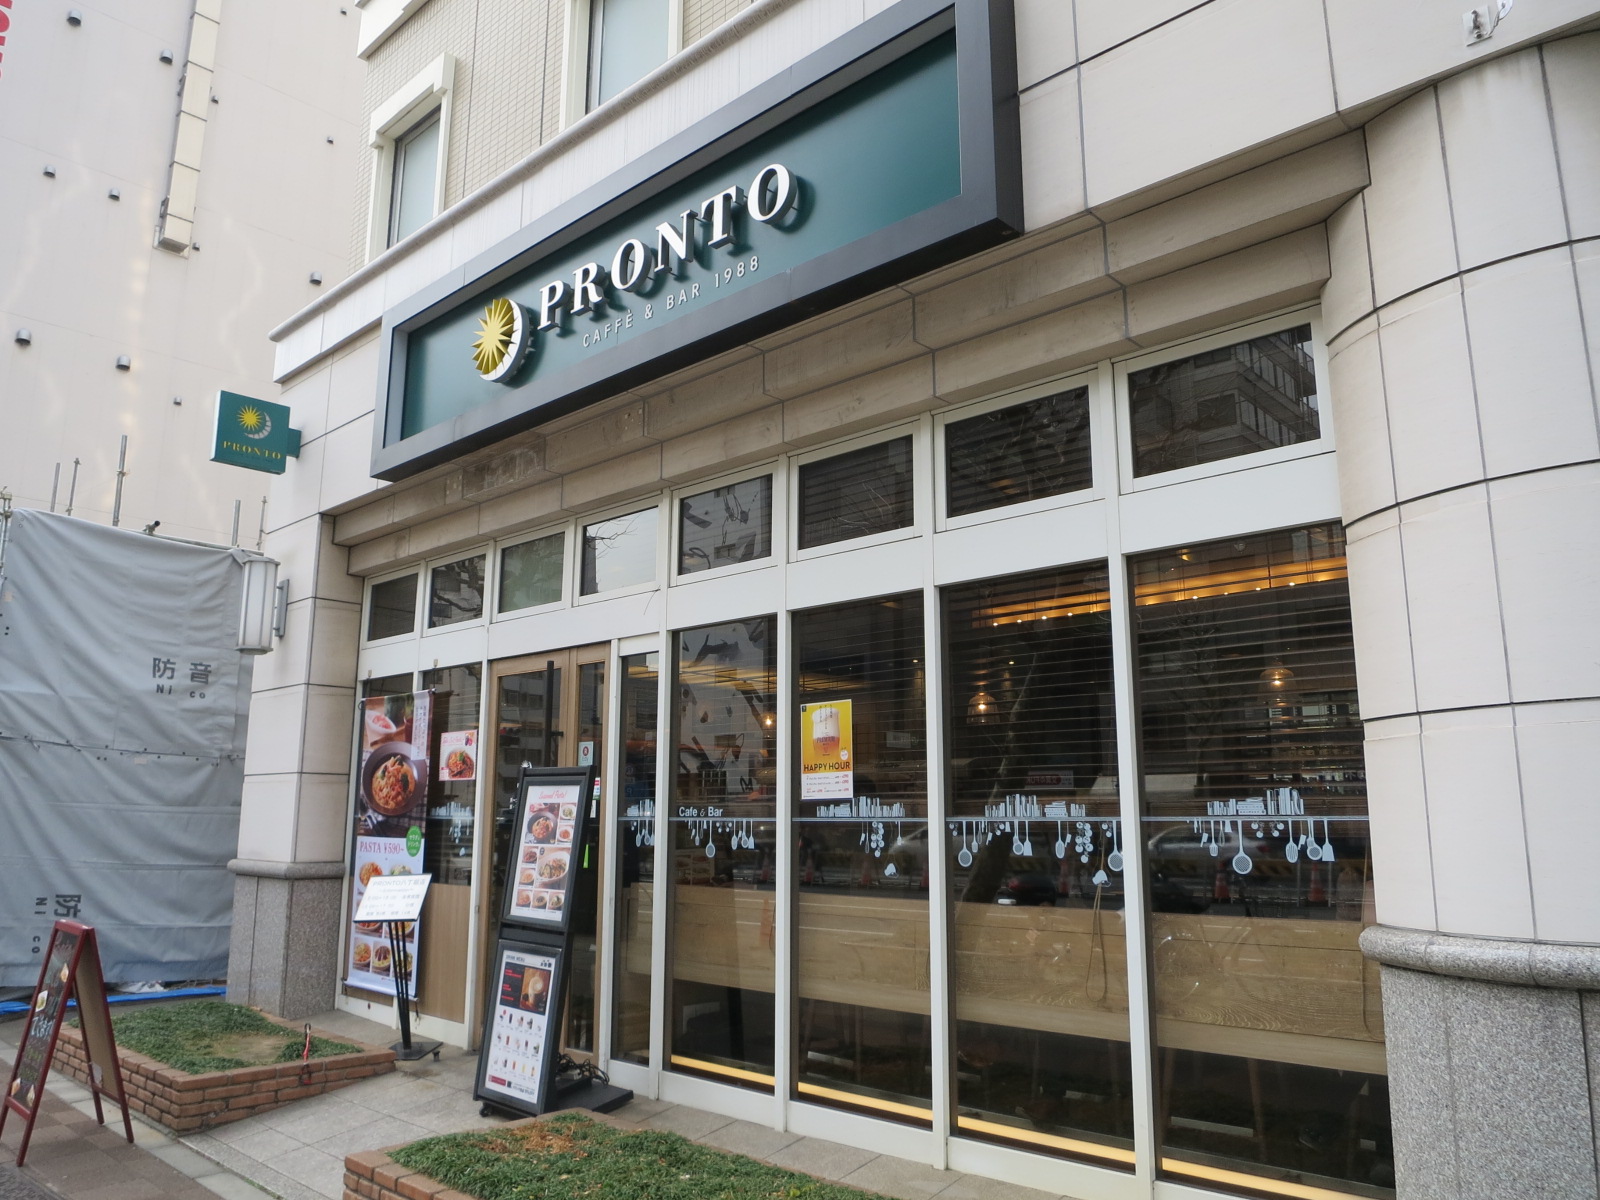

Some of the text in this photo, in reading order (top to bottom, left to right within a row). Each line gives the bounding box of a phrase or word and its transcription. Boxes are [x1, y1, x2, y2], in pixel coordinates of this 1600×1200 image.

[537, 163, 793, 332] PRONTO
[582, 255, 760, 348] CAFFÈ & BAR 1988
[223, 440, 282, 460] PRONTO
[152, 657, 212, 685] 防音
[803, 761, 851, 772] HAPPY HOUR
[678, 806, 698, 817] Cafe
[707, 806, 724, 817] Bar
[359, 840, 381, 853] PASTA
